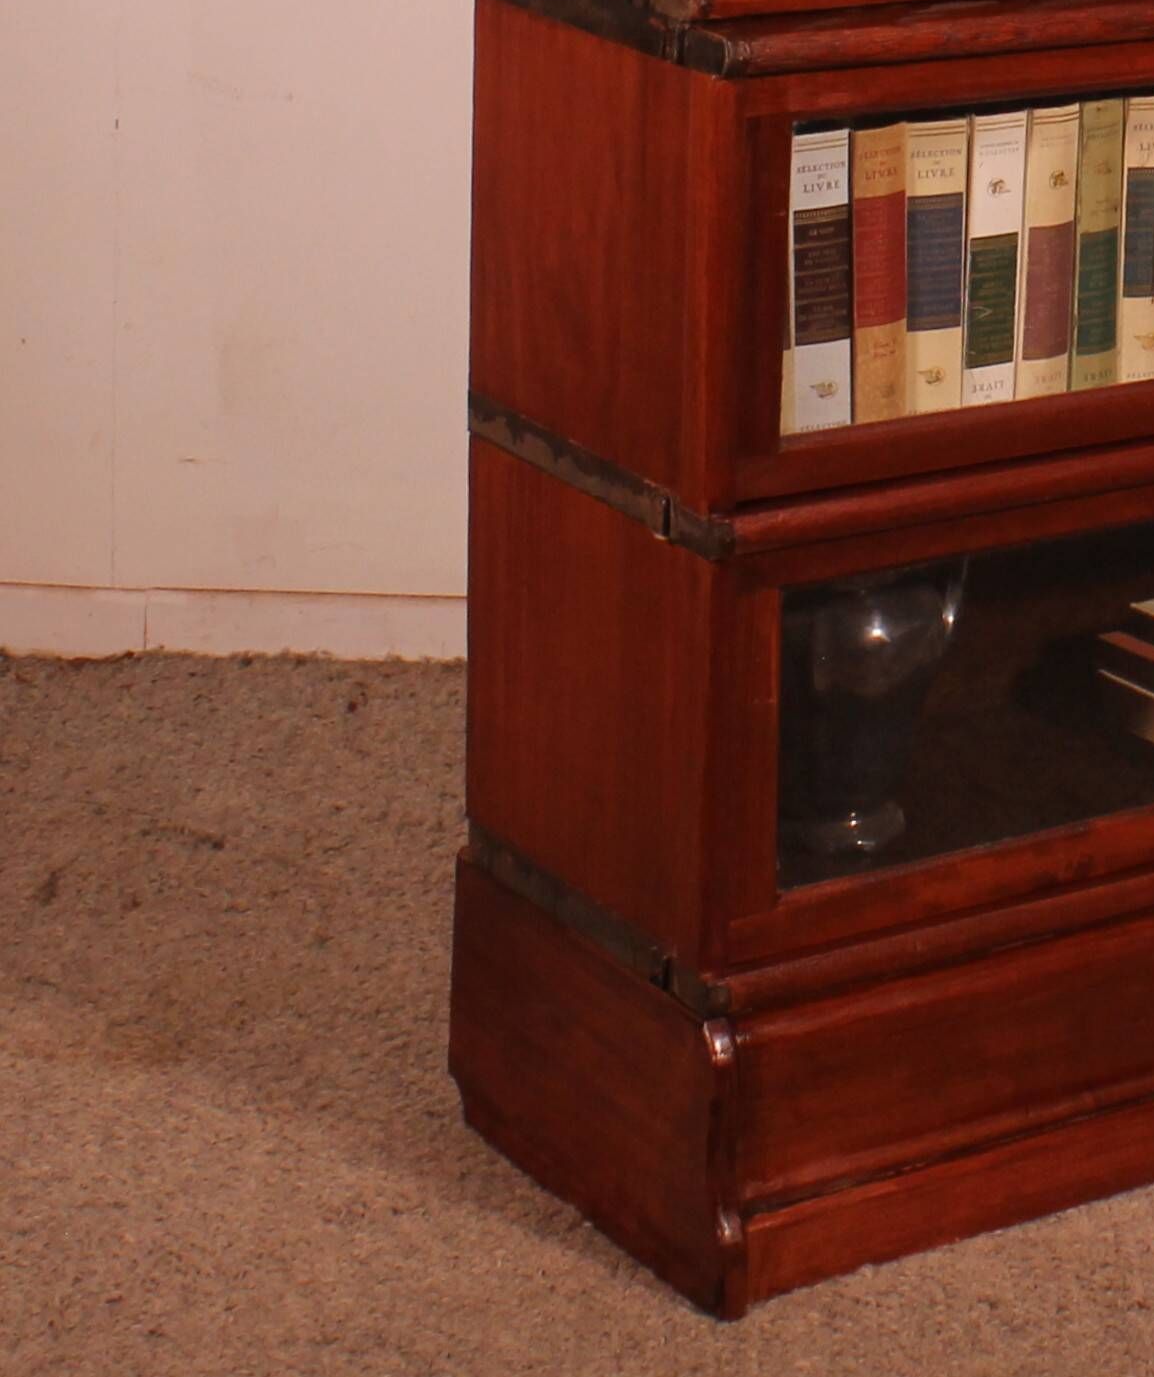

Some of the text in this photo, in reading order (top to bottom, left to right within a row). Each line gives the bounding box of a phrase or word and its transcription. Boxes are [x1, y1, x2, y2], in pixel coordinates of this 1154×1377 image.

[909, 147, 963, 160] SÉLECTION
[796, 160, 847, 174] SÉLECTION
[864, 167, 899, 181] LIVRE
[917, 167, 955, 180] LIVRE
[803, 179, 841, 194] LIVRE
